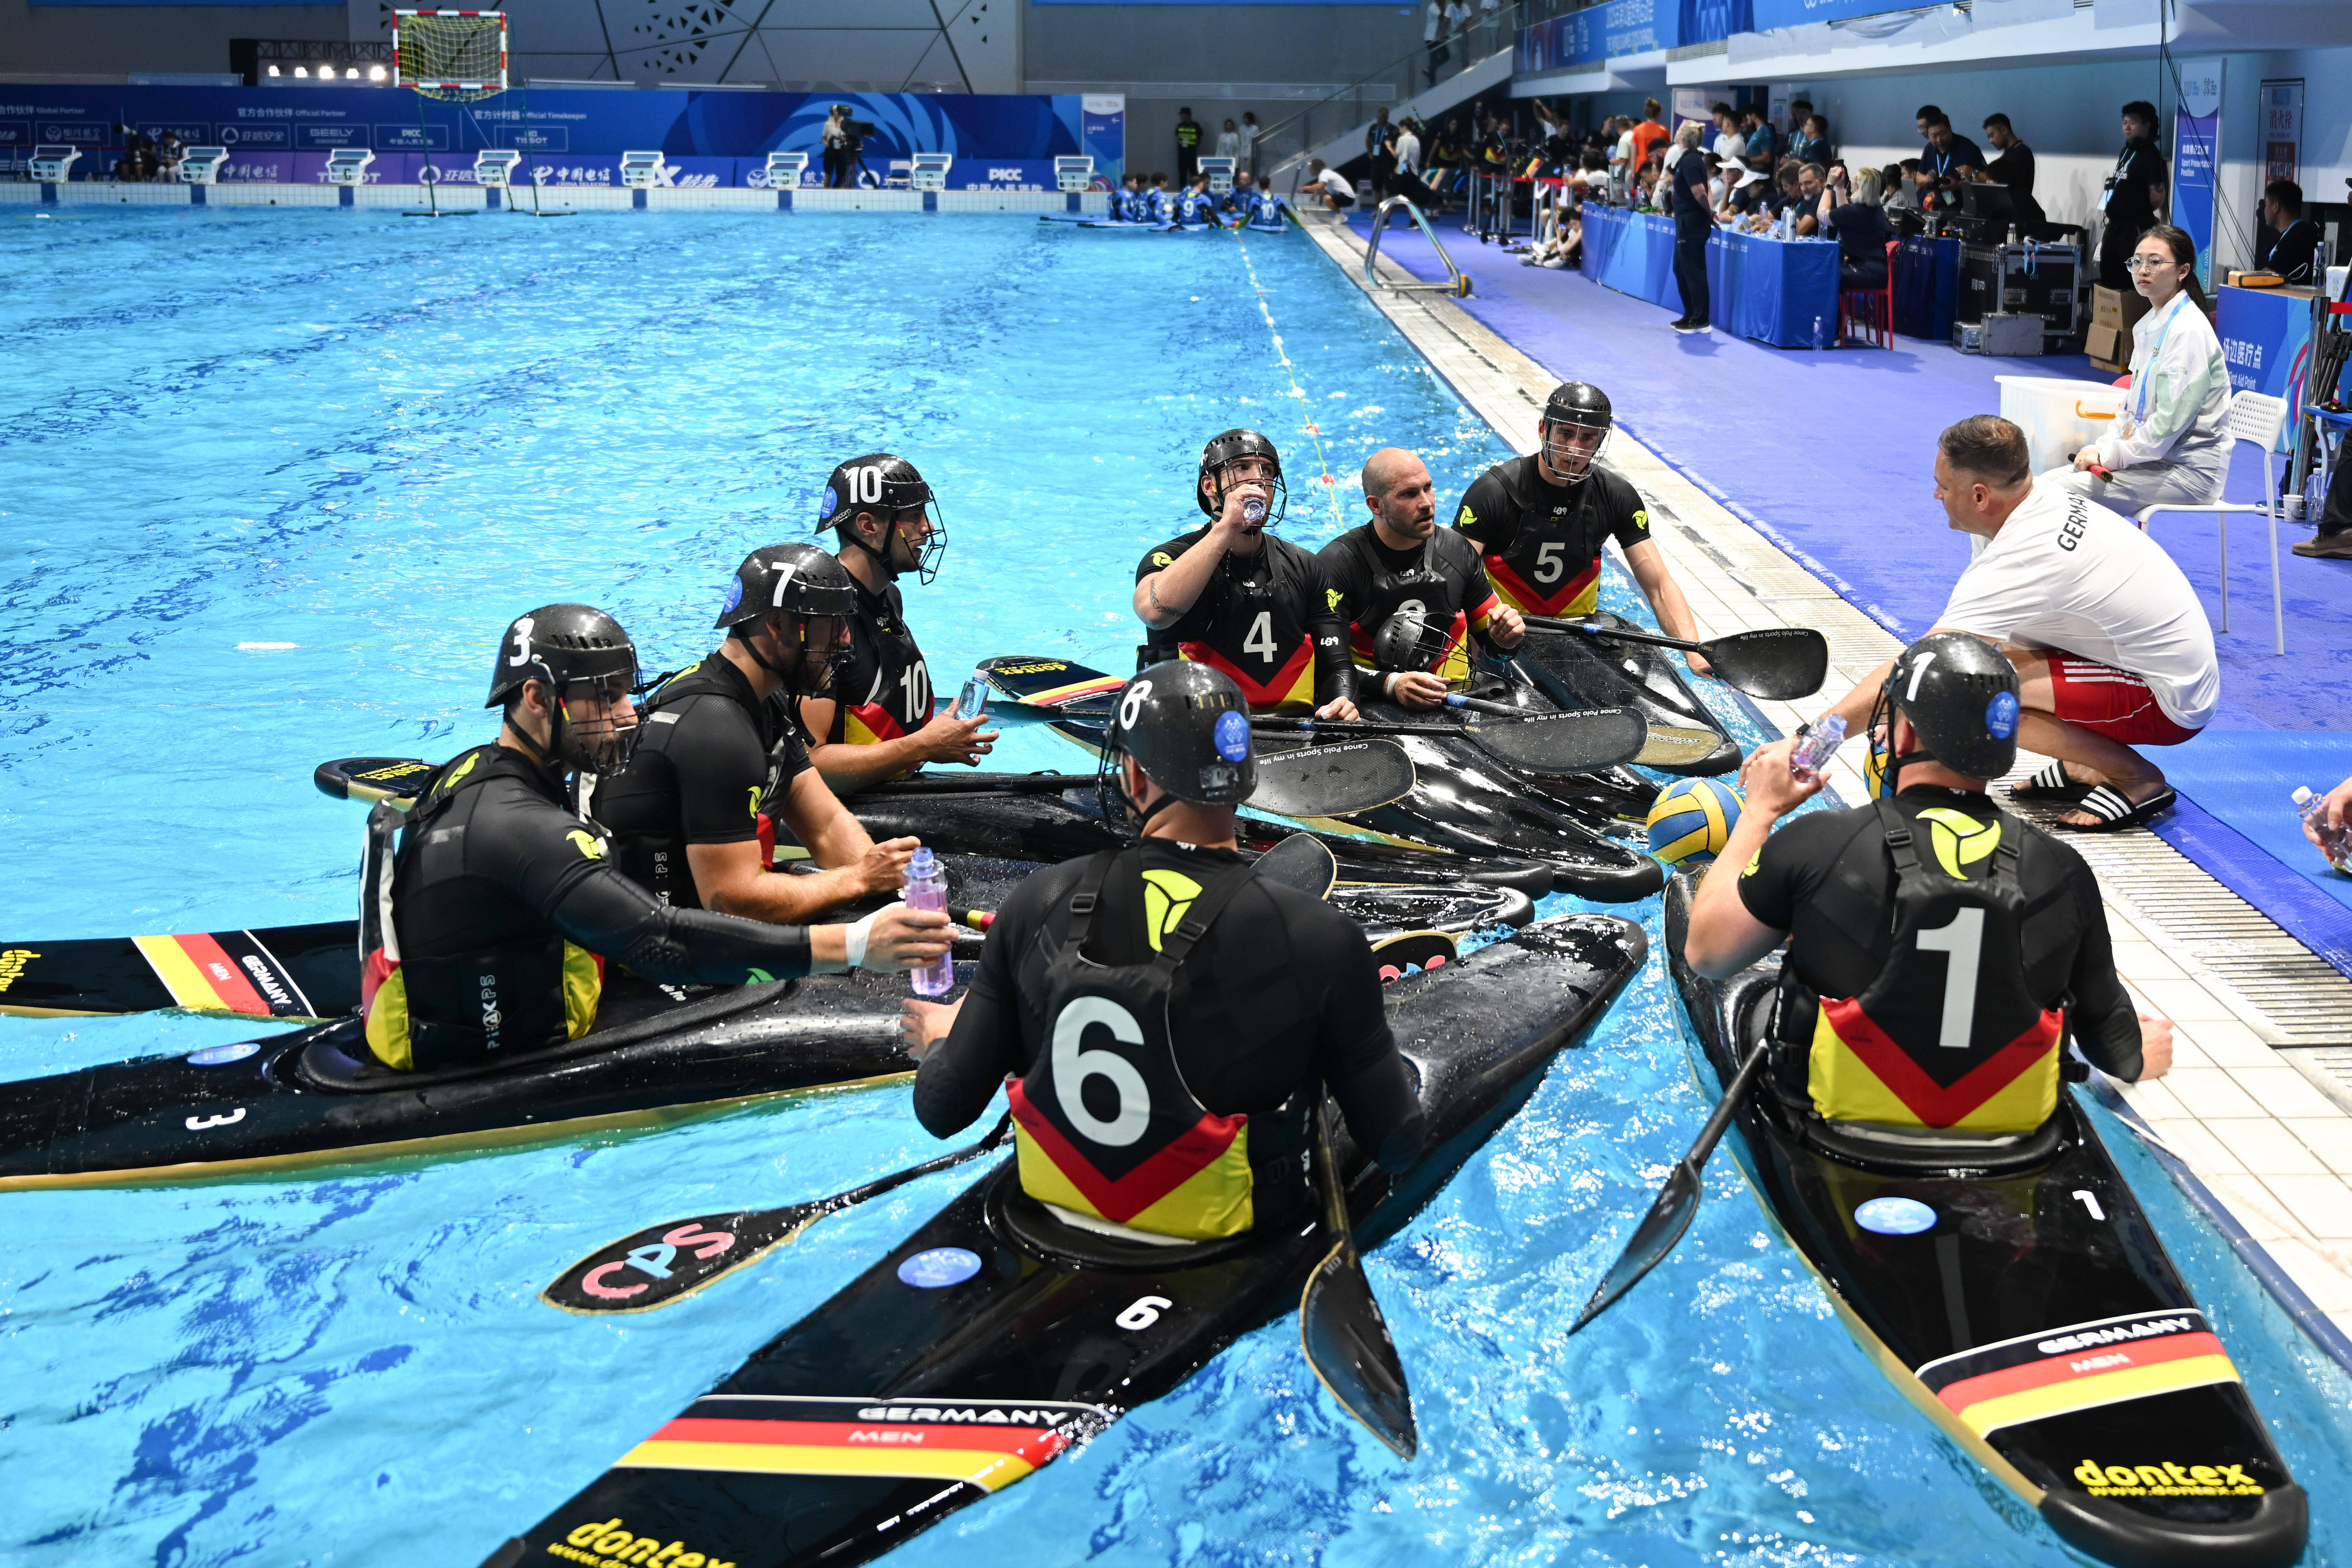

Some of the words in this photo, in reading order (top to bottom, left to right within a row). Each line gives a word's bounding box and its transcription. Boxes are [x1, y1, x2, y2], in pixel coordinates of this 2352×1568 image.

[310, 129, 354, 137] GEELY
[2180, 168, 2194, 177] Position
[2181, 158, 2190, 167] Sport
[556, 167, 610, 181] 中国电信
[989, 169, 1022, 181] PICC
[1184, 201, 1194, 217] 9
[1261, 203, 1274, 219] 10
[2223, 337, 2262, 370] 场边医疗点
[2229, 371, 2237, 386] First
[2244, 376, 2256, 391] Point
[845, 465, 882, 504] 10
[1533, 542, 1565, 583] 5
[771, 561, 796, 608] 7
[509, 617, 535, 667] 3
[1243, 611, 1277, 663] 4
[999, 663, 1067, 675] dontex
[1906, 651, 1937, 702] 1
[900, 660, 928, 723] 10
[1120, 680, 1153, 731] 6
[1296, 748, 1322, 758] Sports
[1324, 746, 1341, 754] Polo
[208, 962, 233, 981] MEN
[242, 955, 292, 1005] GERMANY
[1916, 906, 1985, 1048] 1
[1051, 995, 1151, 1147] 6
[185, 1108, 247, 1130] 3
[2072, 1190, 2105, 1221] 1
[1115, 1295, 1173, 1331] 6
[2037, 1317, 2192, 1354] GERMANY
[2069, 1353, 2131, 1373] MEN
[857, 1406, 1069, 1426] GERMANY
[848, 1431, 924, 1444] MEN
[2074, 1458, 2257, 1487] dontex
[2087, 1483, 2265, 1496] www.dontex.de
